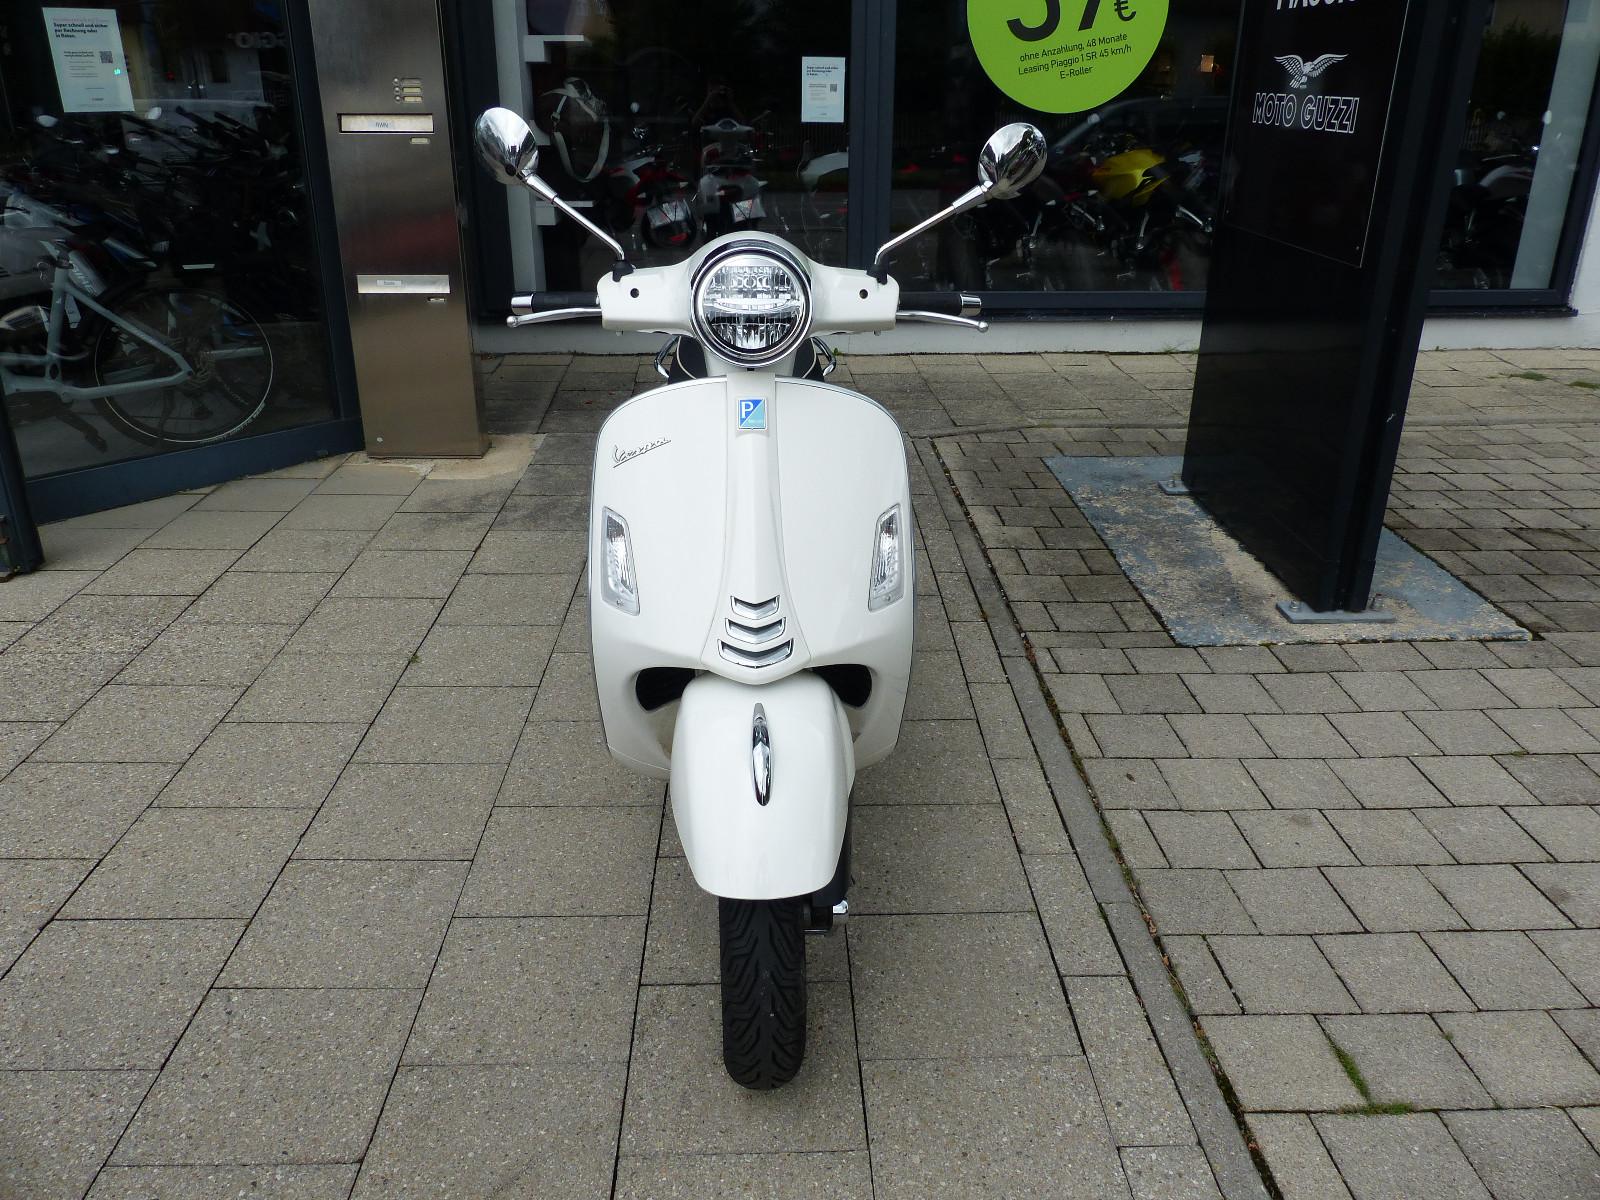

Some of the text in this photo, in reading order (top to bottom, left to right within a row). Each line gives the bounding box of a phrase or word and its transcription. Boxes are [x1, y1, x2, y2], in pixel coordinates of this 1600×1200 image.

[1018, 62, 1049, 75] Leasing
[1050, 57, 1080, 69] Piaggio
[1086, 51, 1097, 61] SR
[1099, 48, 1109, 58] 45
[1111, 44, 1132, 56] km/h
[1019, 33, 1128, 62] ohne Anzahlung, 48 Monate
[1060, 66, 1093, 79] E-Roller
[1252, 92, 1360, 133] MOTO GUZZI
